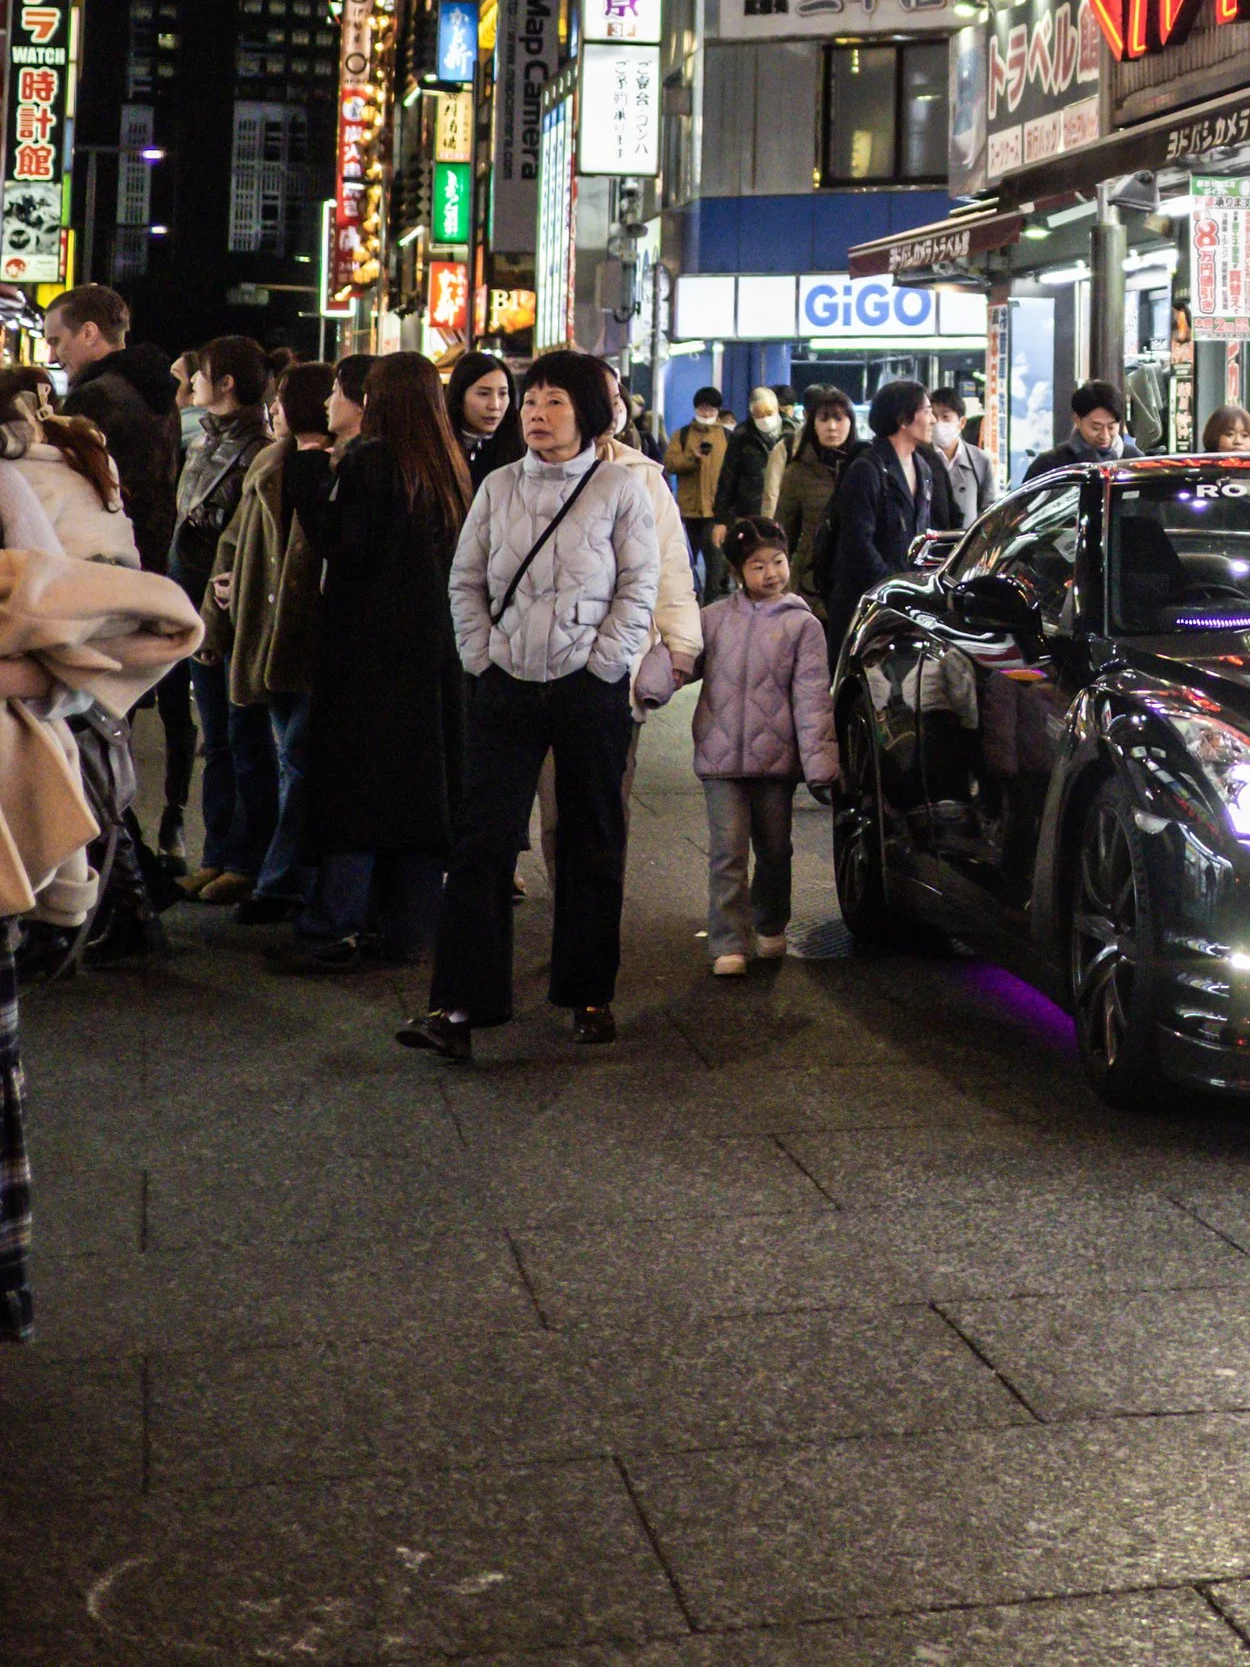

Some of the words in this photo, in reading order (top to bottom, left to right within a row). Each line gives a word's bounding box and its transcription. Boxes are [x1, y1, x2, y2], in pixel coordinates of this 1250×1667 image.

[12, 46, 66, 65] WATCH
[987, 1, 1100, 121] トラベル館
[14, 66, 58, 181] 時計館
[520, 60, 550, 181] Camera
[1165, 108, 1250, 161] ヨドバシカメラ
[804, 283, 931, 327] GiGO
